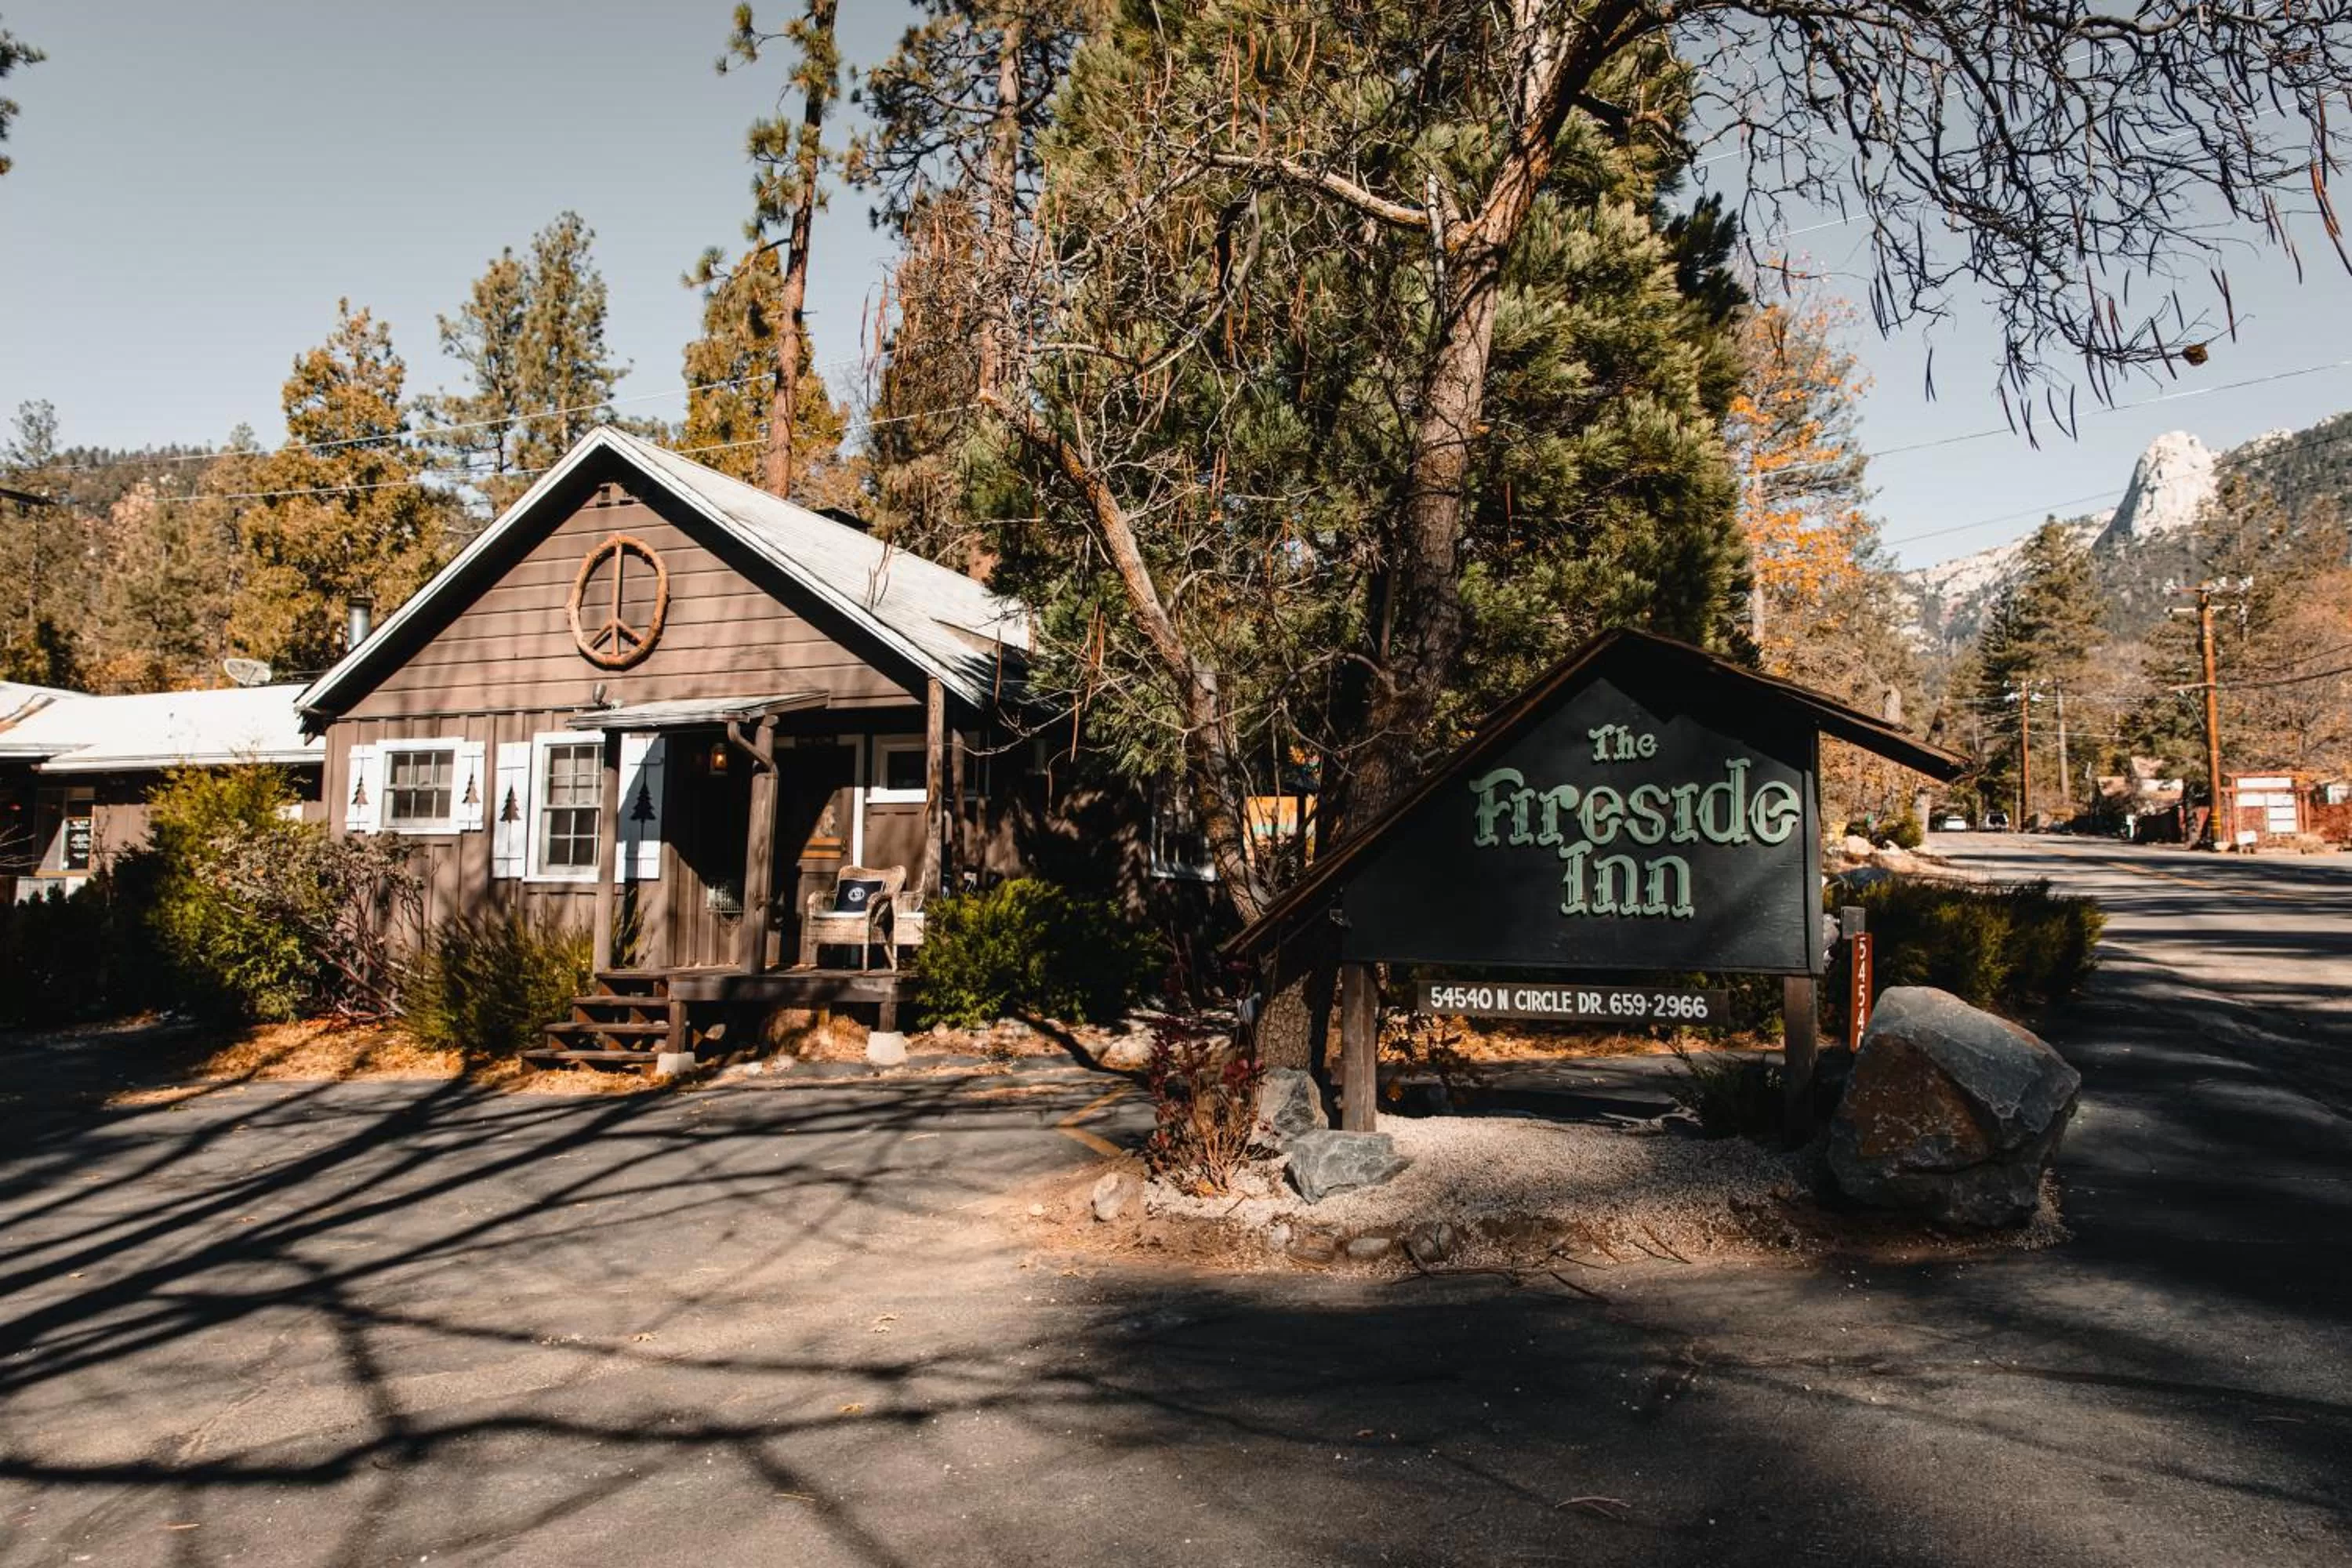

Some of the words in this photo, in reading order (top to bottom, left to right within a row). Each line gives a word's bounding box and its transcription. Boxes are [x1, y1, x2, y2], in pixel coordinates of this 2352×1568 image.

[1588, 724, 1658, 761] The
[1470, 758, 1801, 847] Fireside
[1559, 839, 1695, 918] Inn
[1430, 986, 1492, 1009] 54540
[1497, 988, 1509, 1011] N
[1515, 989, 1573, 1014] CIRCLE
[1577, 992, 1607, 1015] DR.
